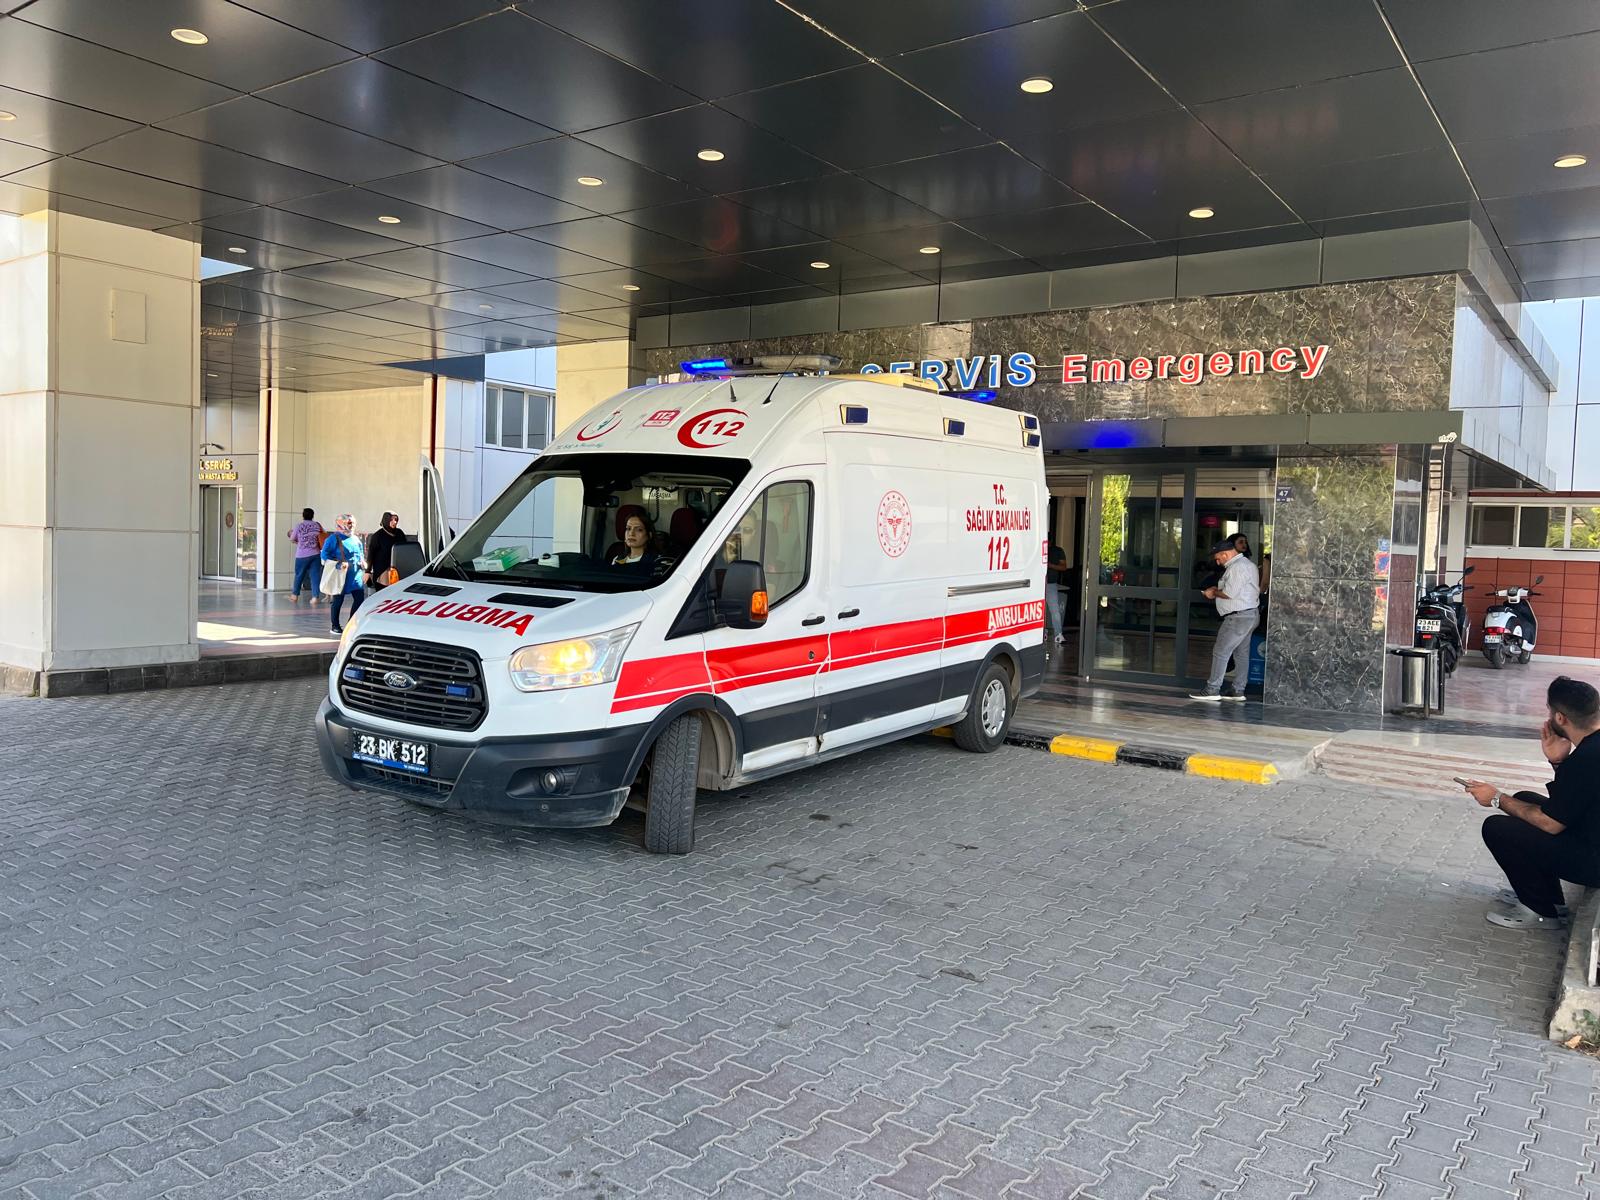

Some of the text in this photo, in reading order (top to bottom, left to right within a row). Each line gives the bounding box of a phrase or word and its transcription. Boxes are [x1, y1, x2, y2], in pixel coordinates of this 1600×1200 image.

[1062, 345, 1330, 385] Emergency
[653, 411, 676, 420] 112
[697, 420, 745, 437] 112
[993, 484, 1007, 505] T.C.
[966, 506, 1031, 531] SAĞLIK BAKANLIĞI
[988, 536, 1010, 571] 112
[988, 601, 1043, 630] AMBULANS
[388, 674, 407, 687] Ford
[360, 735, 376, 755] 23
[379, 739, 396, 761] BK
[401, 743, 426, 765] 512
